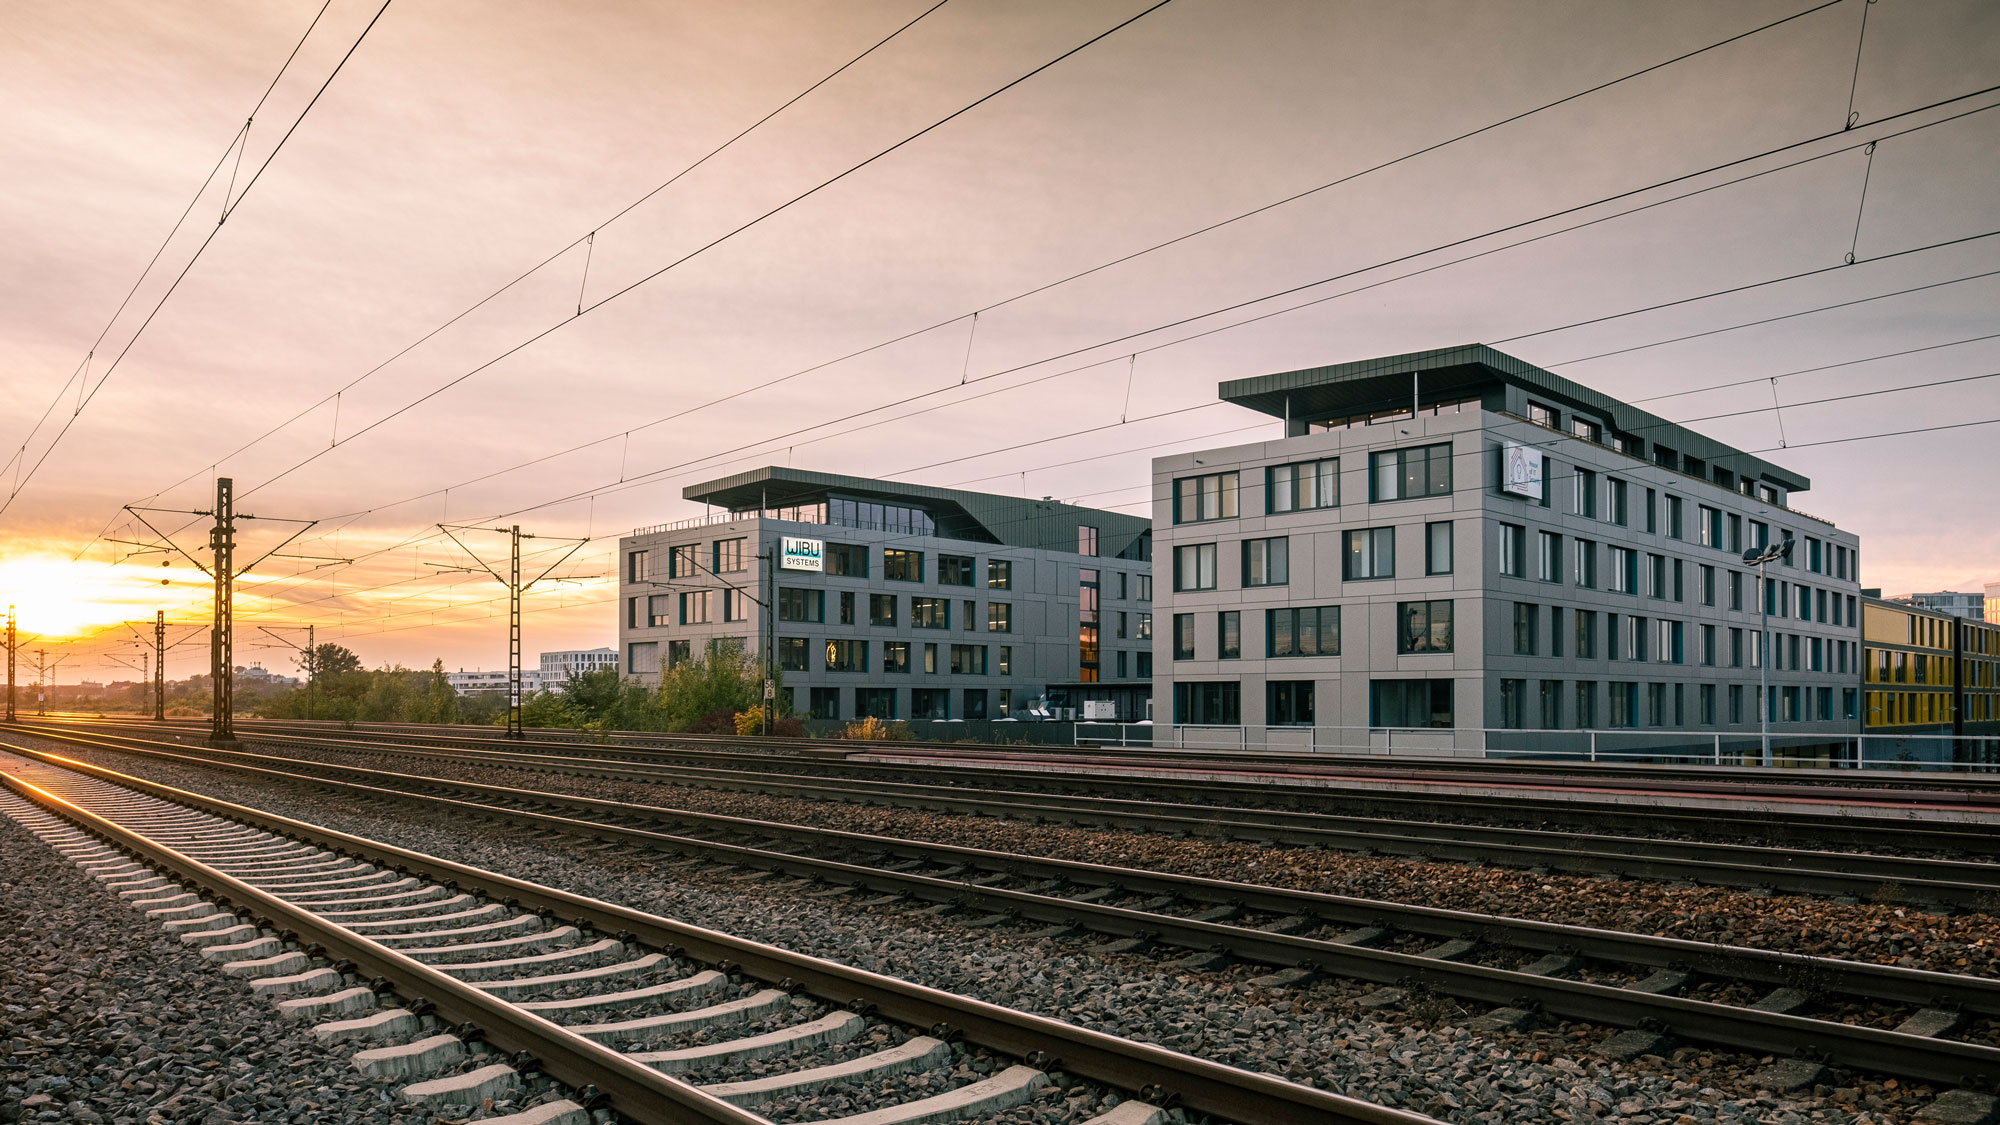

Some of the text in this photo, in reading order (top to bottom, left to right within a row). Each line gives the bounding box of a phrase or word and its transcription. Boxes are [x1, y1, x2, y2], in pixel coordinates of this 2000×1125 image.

[786, 540, 820, 557] WIBU
[786, 557, 820, 567] SYSTEMS
[765, 680, 775, 689] 58
[767, 689, 773, 698] 8
